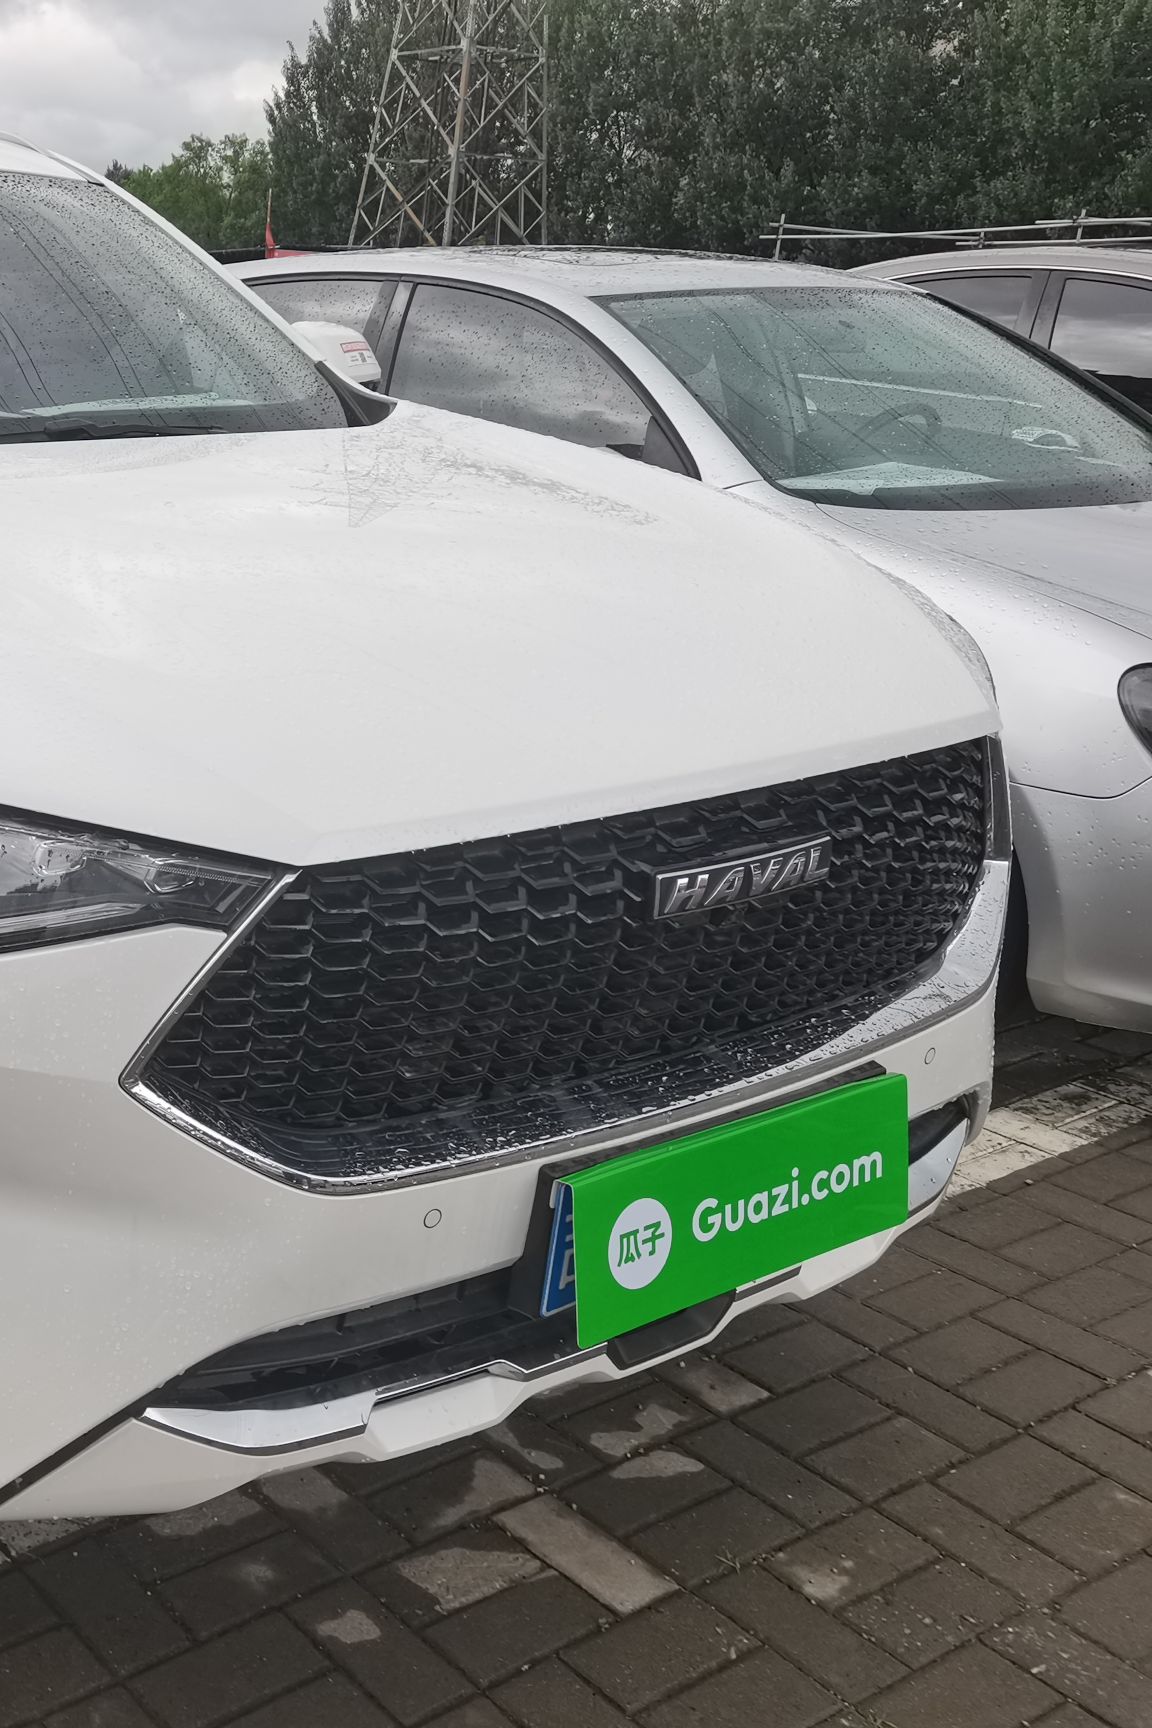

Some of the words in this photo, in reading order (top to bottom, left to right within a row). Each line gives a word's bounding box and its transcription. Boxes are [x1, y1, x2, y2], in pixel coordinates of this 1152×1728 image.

[663, 847, 830, 914] HAVAL
[691, 1151, 883, 1242] Guazi.com
[617, 1220, 666, 1268] 瓜子
